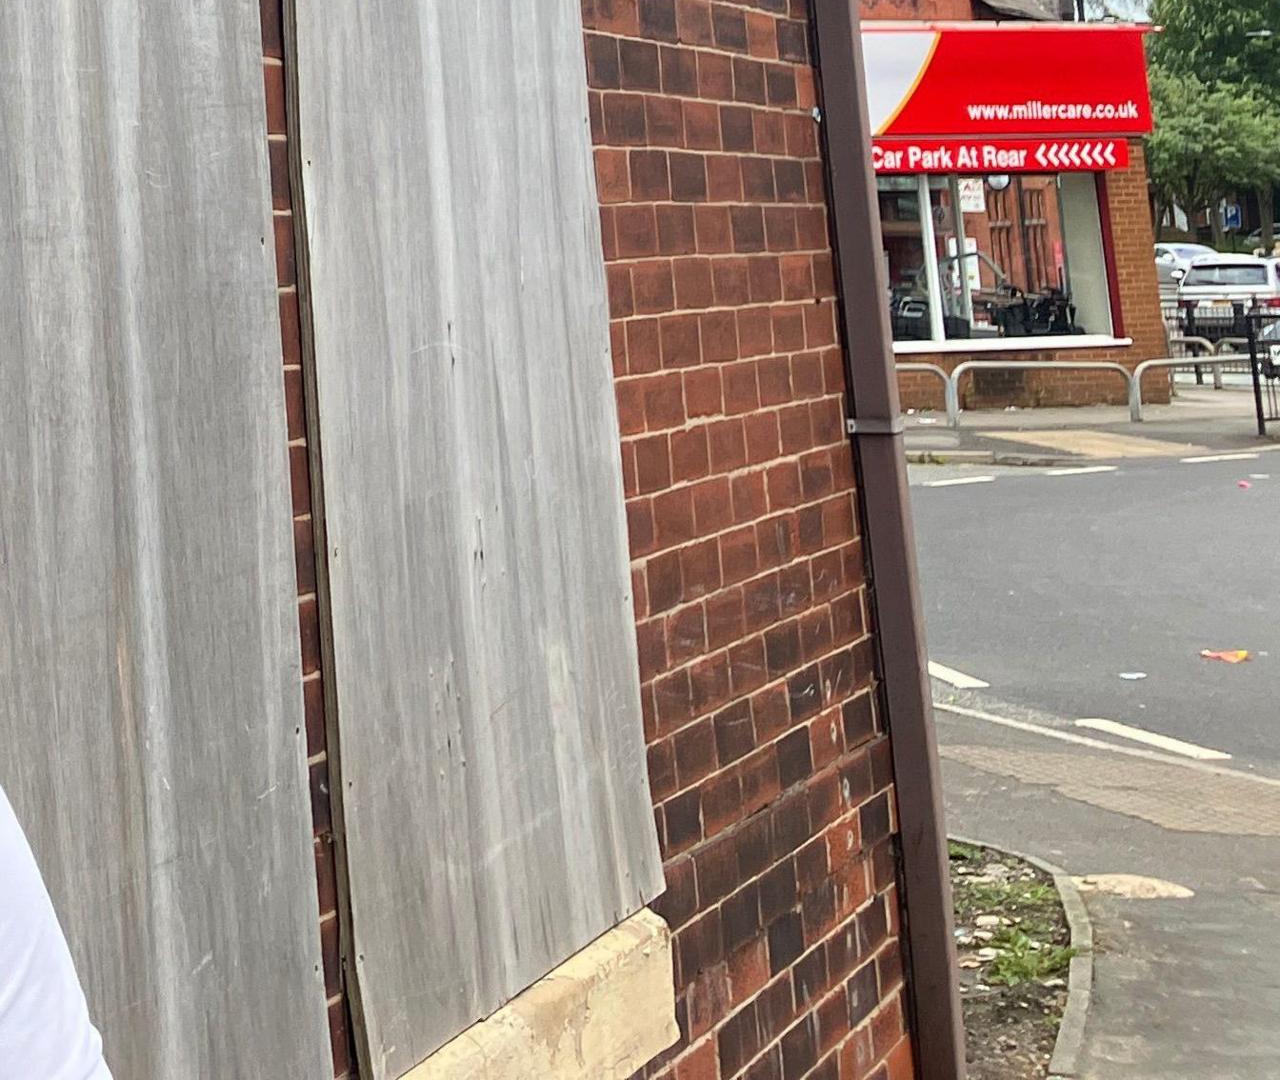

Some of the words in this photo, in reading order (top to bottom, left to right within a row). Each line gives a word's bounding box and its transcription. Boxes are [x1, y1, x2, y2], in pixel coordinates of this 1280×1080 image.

[967, 100, 1139, 121] www.millercare.co.uk
[871, 146, 903, 169] Car
[908, 145, 954, 169] Park
[957, 145, 979, 169] At
[982, 145, 1028, 168] Rear
